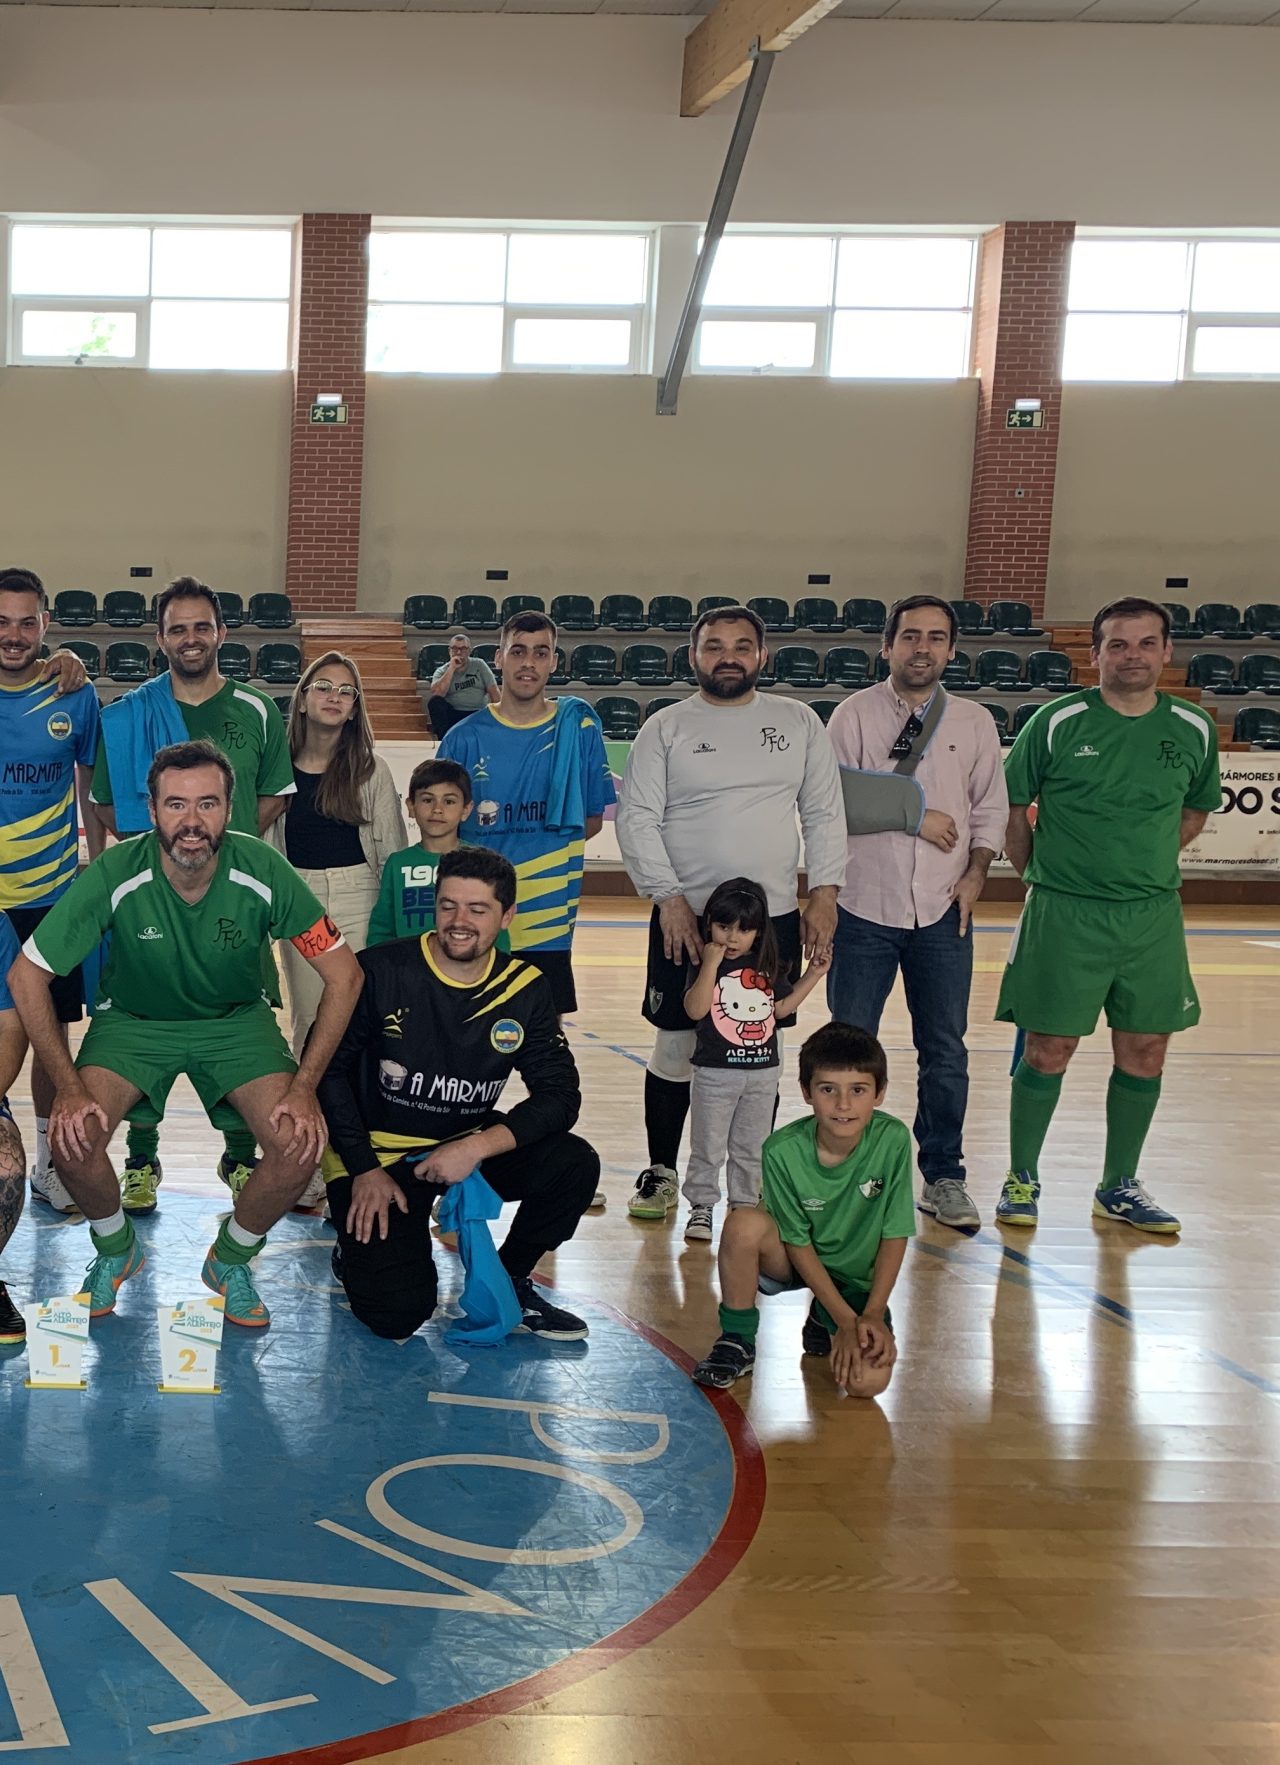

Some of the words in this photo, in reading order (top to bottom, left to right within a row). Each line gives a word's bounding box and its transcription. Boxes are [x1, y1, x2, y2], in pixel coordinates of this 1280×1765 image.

[760, 727, 790, 752] PFC
[2, 762, 63, 784] MARMITA
[401, 865, 437, 888] 19
[213, 917, 246, 951] PFC
[410, 1072, 424, 1096] A
[53, 1317, 88, 1325] ALENTEJO
[186, 1321, 221, 1329] ALENTEJO
[48, 1344, 60, 1367] 1
[178, 1348, 197, 1372] 2
